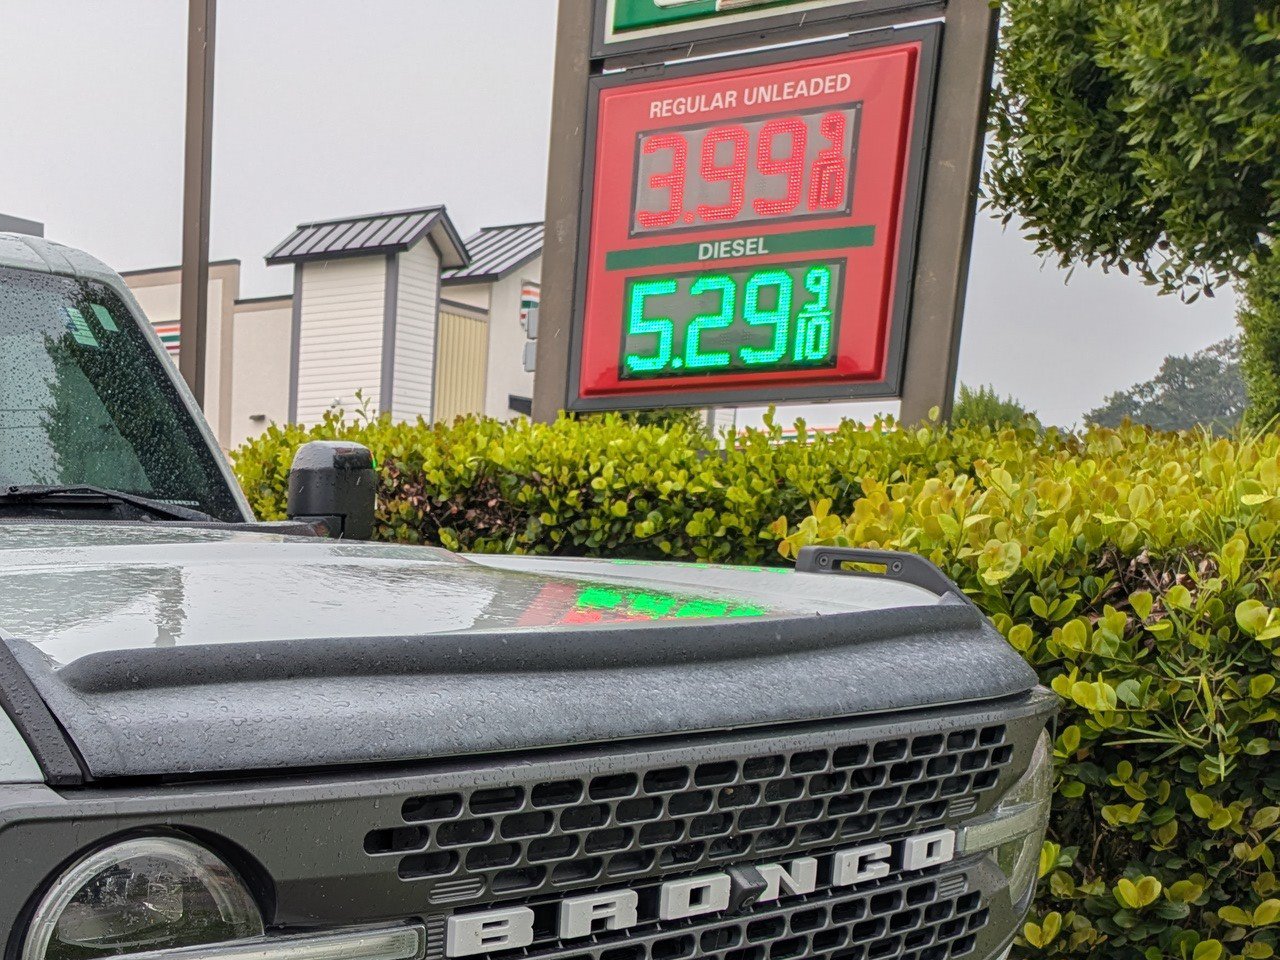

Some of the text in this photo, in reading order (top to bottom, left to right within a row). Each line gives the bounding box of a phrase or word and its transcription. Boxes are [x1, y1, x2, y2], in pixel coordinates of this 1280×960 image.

[649, 73, 851, 118] REGULAR UNLEADED
[636, 117, 808, 227] 3.99
[697, 237, 769, 261] DIESEL
[625, 268, 794, 372] 5.29
[446, 828, 955, 958] BRONCO
